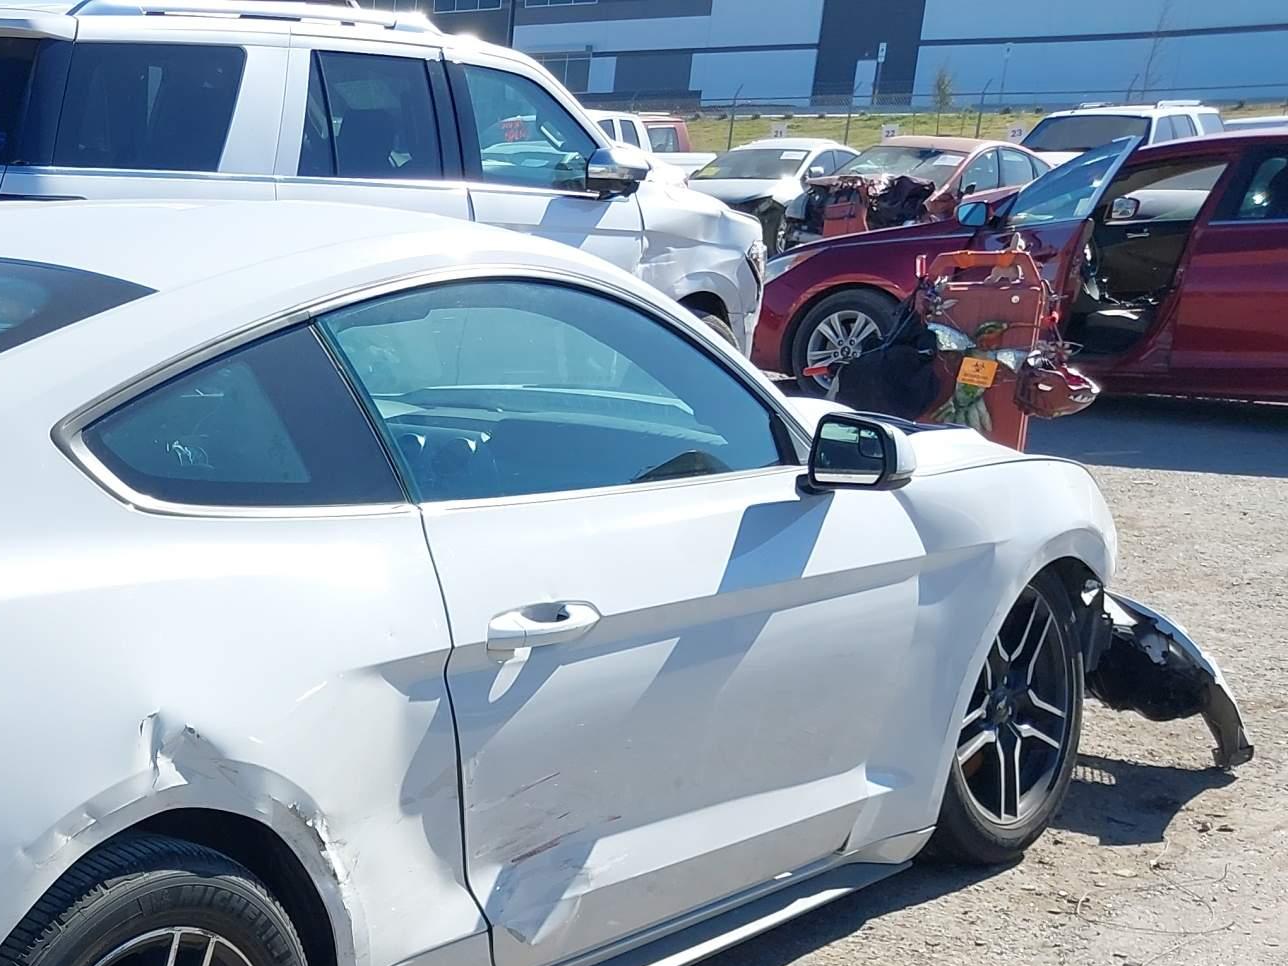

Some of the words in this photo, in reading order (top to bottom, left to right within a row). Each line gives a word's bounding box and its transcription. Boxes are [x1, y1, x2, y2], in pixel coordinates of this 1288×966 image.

[773, 129, 783, 138] 21
[885, 129, 896, 138] 22
[1011, 128, 1023, 138] 23
[179, 884, 293, 964] MICHELIN
